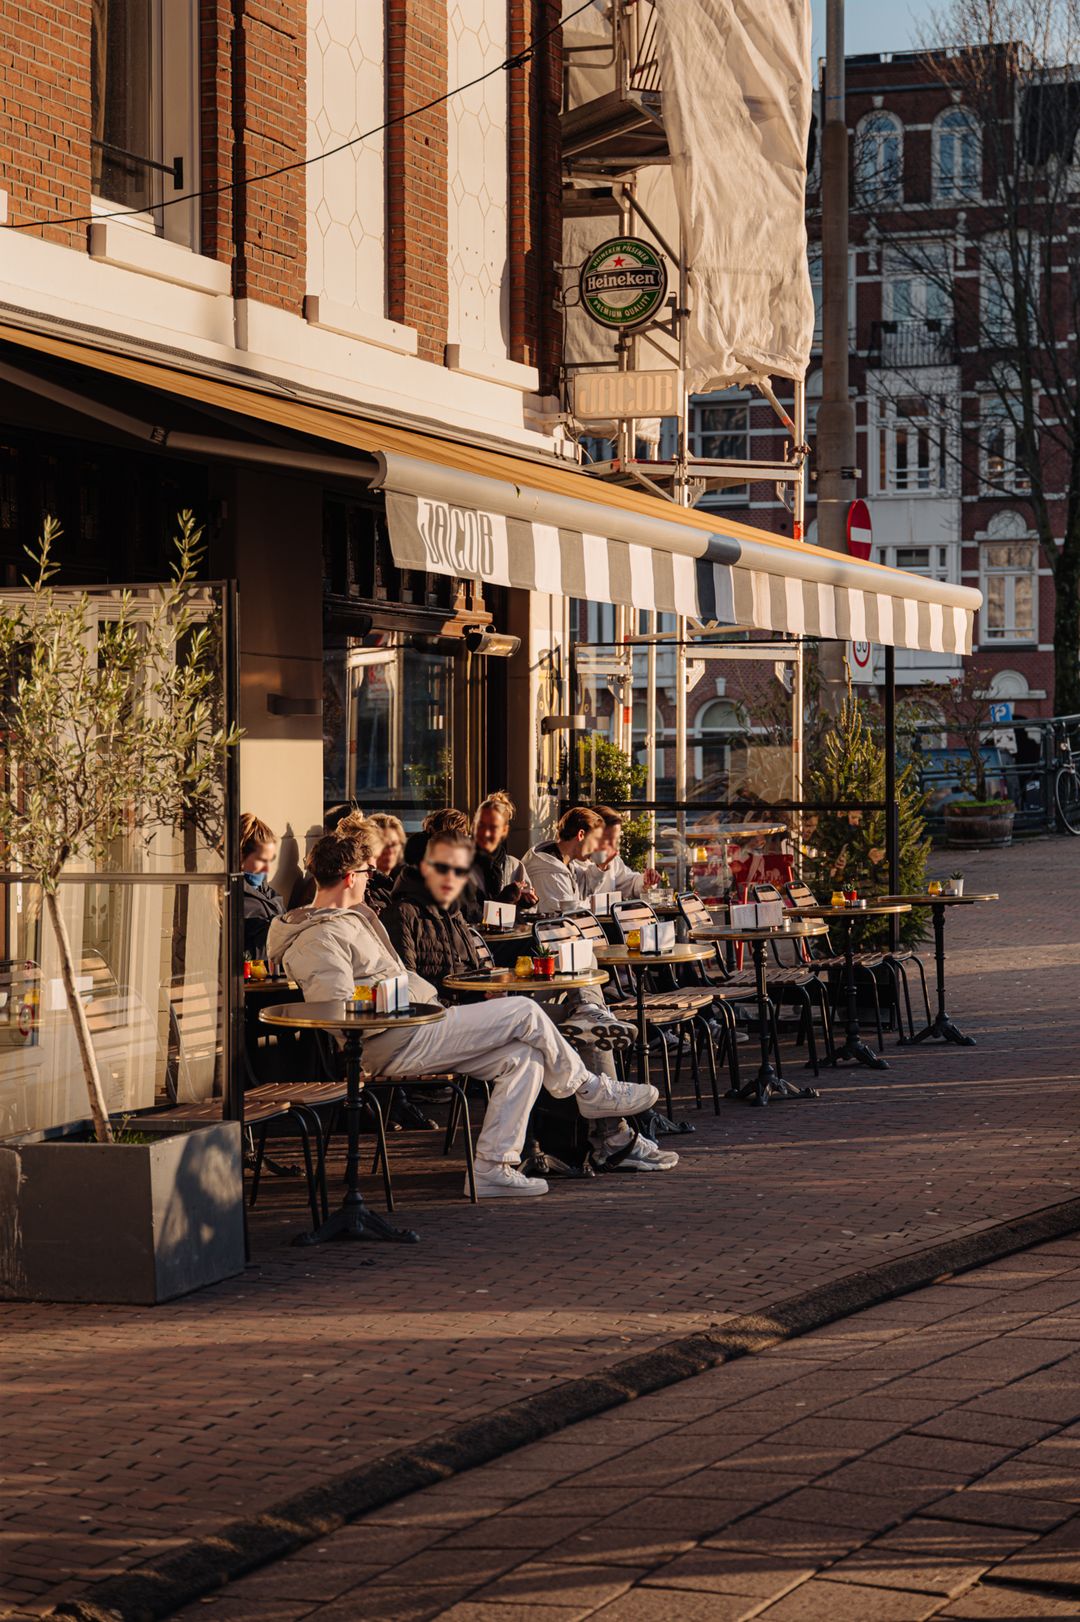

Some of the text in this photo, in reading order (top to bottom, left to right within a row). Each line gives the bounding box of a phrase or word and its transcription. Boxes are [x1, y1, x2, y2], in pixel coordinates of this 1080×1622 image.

[592, 246, 621, 267] HEINEKEN
[587, 272, 655, 291] Heineken
[592, 295, 651, 318] PREMIUM QUALITY
[578, 375, 673, 414] JACOB
[421, 502, 495, 576] JACOB
